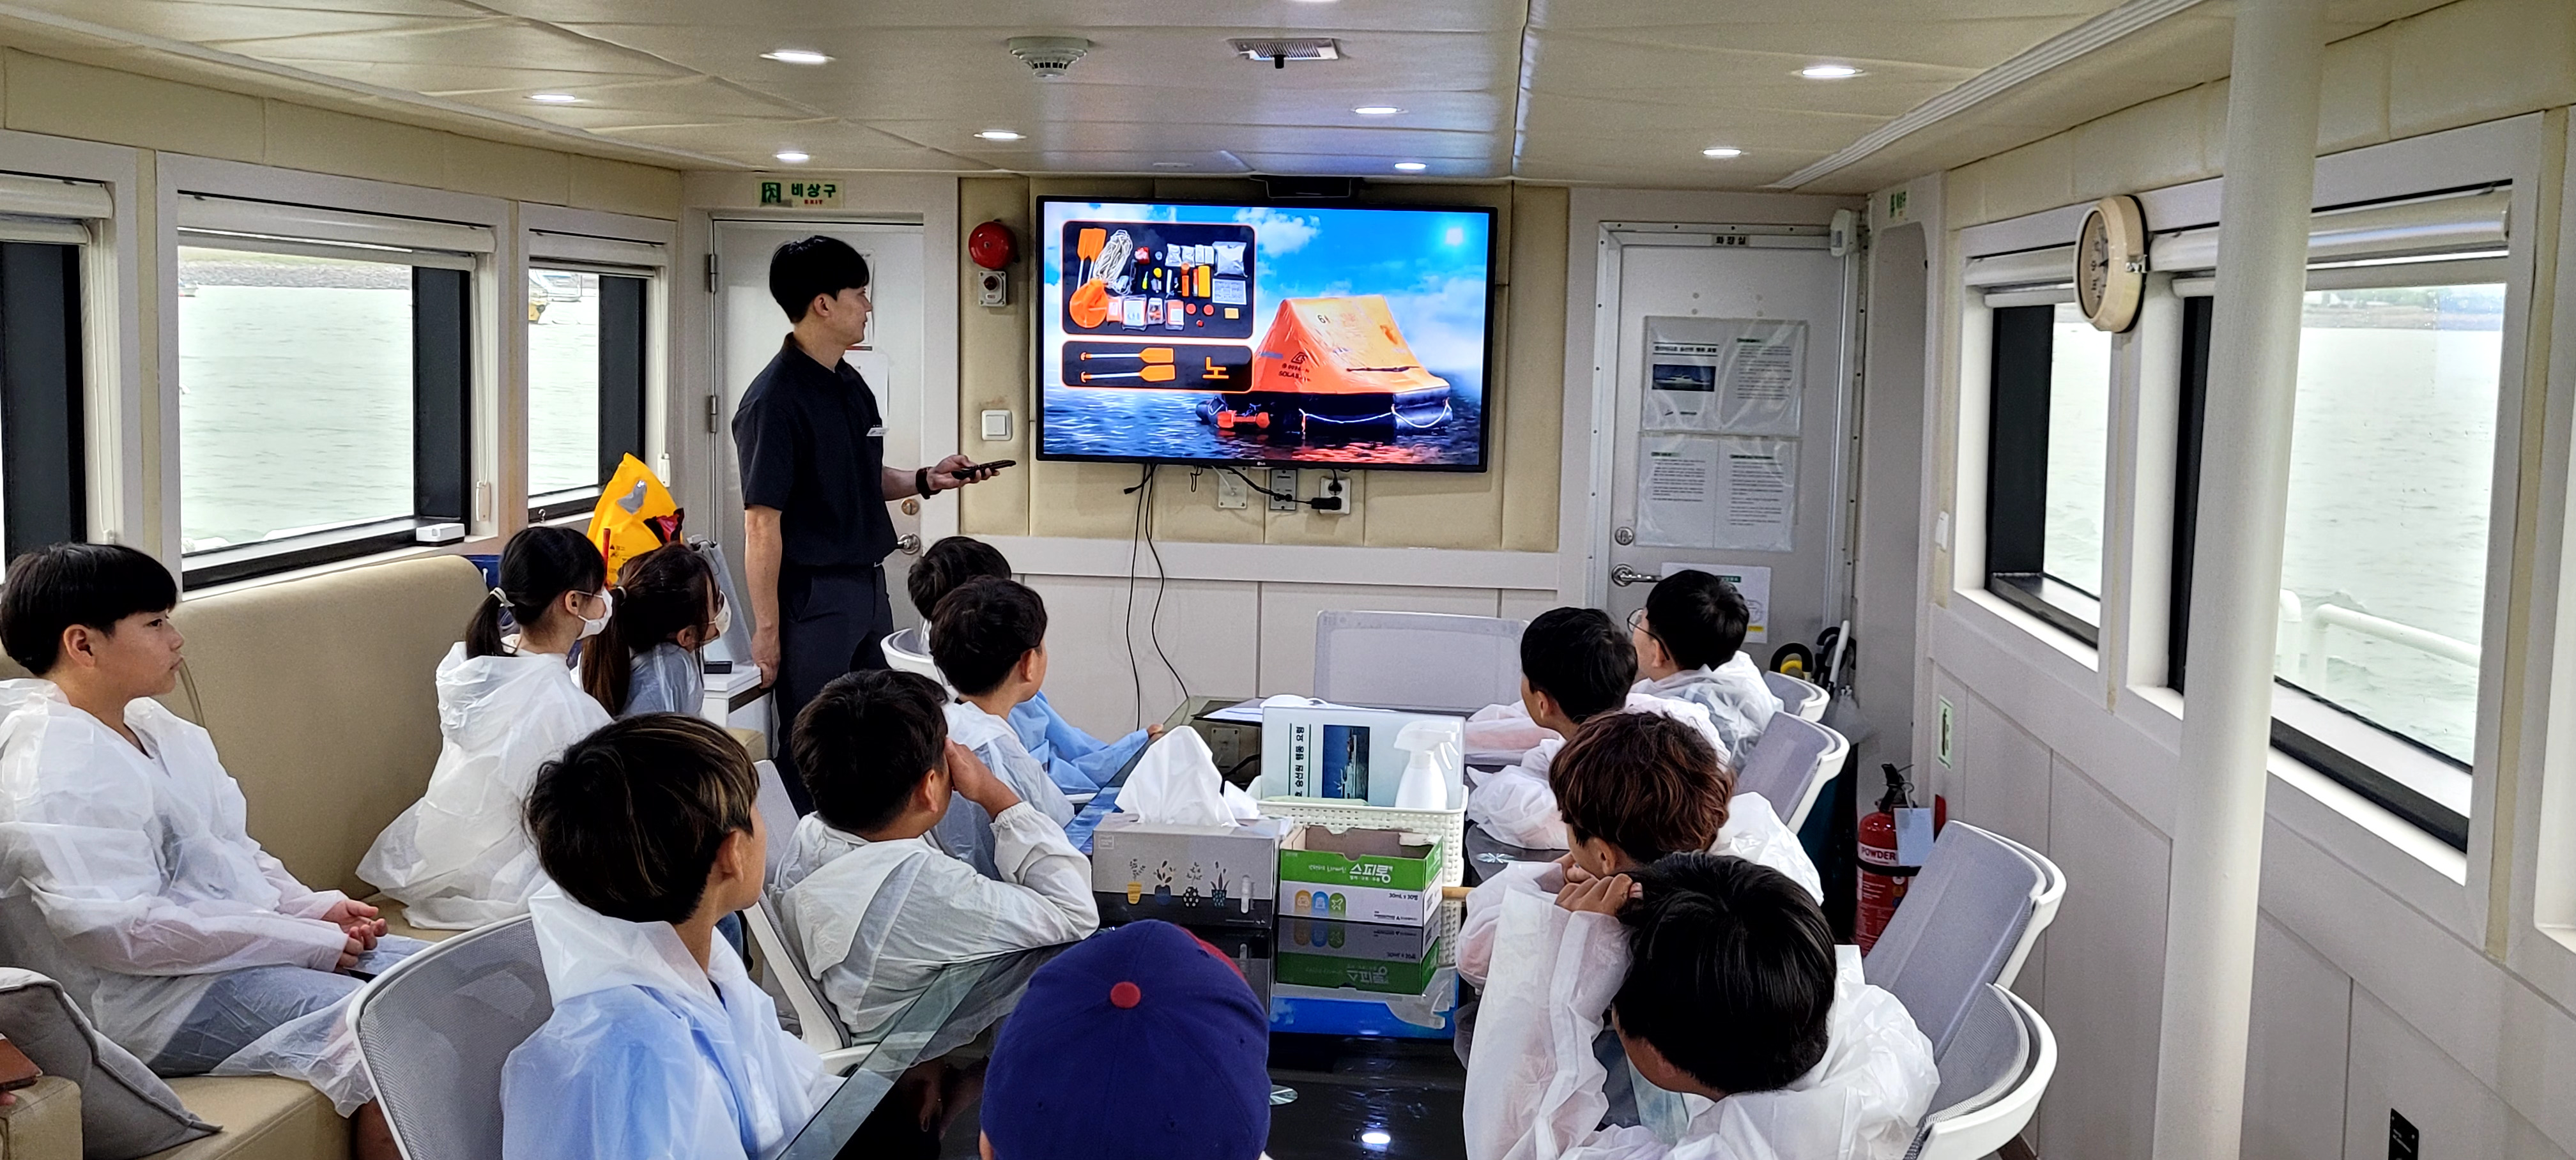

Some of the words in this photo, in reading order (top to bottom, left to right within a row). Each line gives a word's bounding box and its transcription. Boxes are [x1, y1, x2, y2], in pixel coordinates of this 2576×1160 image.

[791, 183, 836, 198] 비상구
[1716, 236, 1746, 245] 화장실
[1202, 356, 1229, 379] 노
[1295, 745, 1304, 761] 행동
[1294, 765, 1304, 788] 승선원
[1862, 846, 1896, 860] POWDER
[1349, 863, 1392, 884] 스피롱
